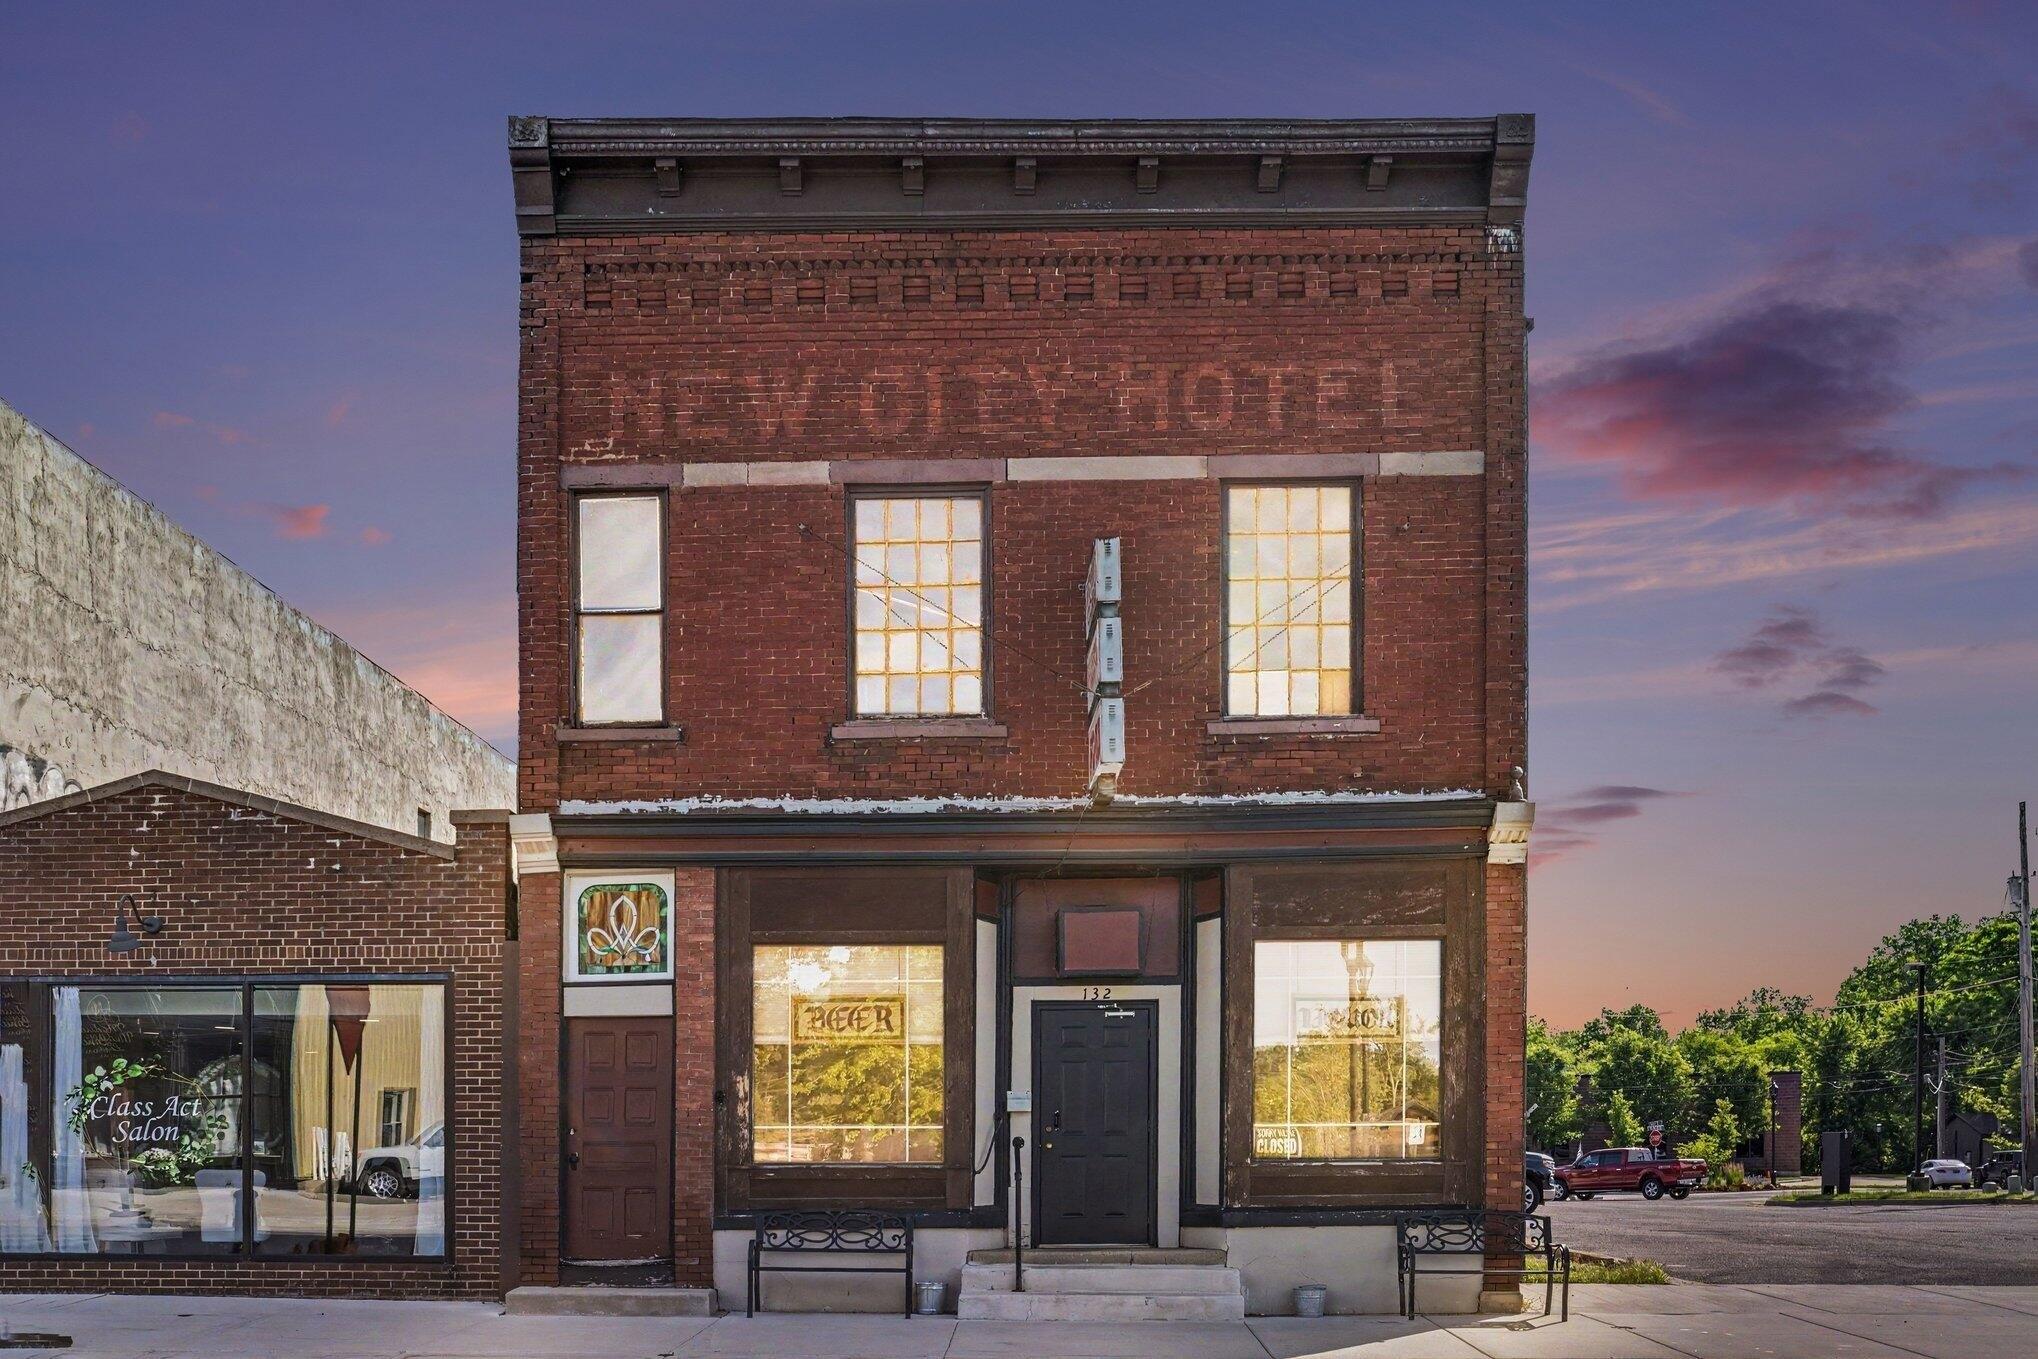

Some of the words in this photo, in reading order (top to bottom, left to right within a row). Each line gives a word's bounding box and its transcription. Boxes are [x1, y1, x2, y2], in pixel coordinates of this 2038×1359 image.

[1083, 987, 1112, 1001] 132
[804, 1004, 895, 1033] BEER
[90, 1093, 153, 1121] Class
[156, 1095, 203, 1120] Act
[111, 1117, 180, 1143] Salon
[1256, 1138, 1297, 1154] CLOSED
